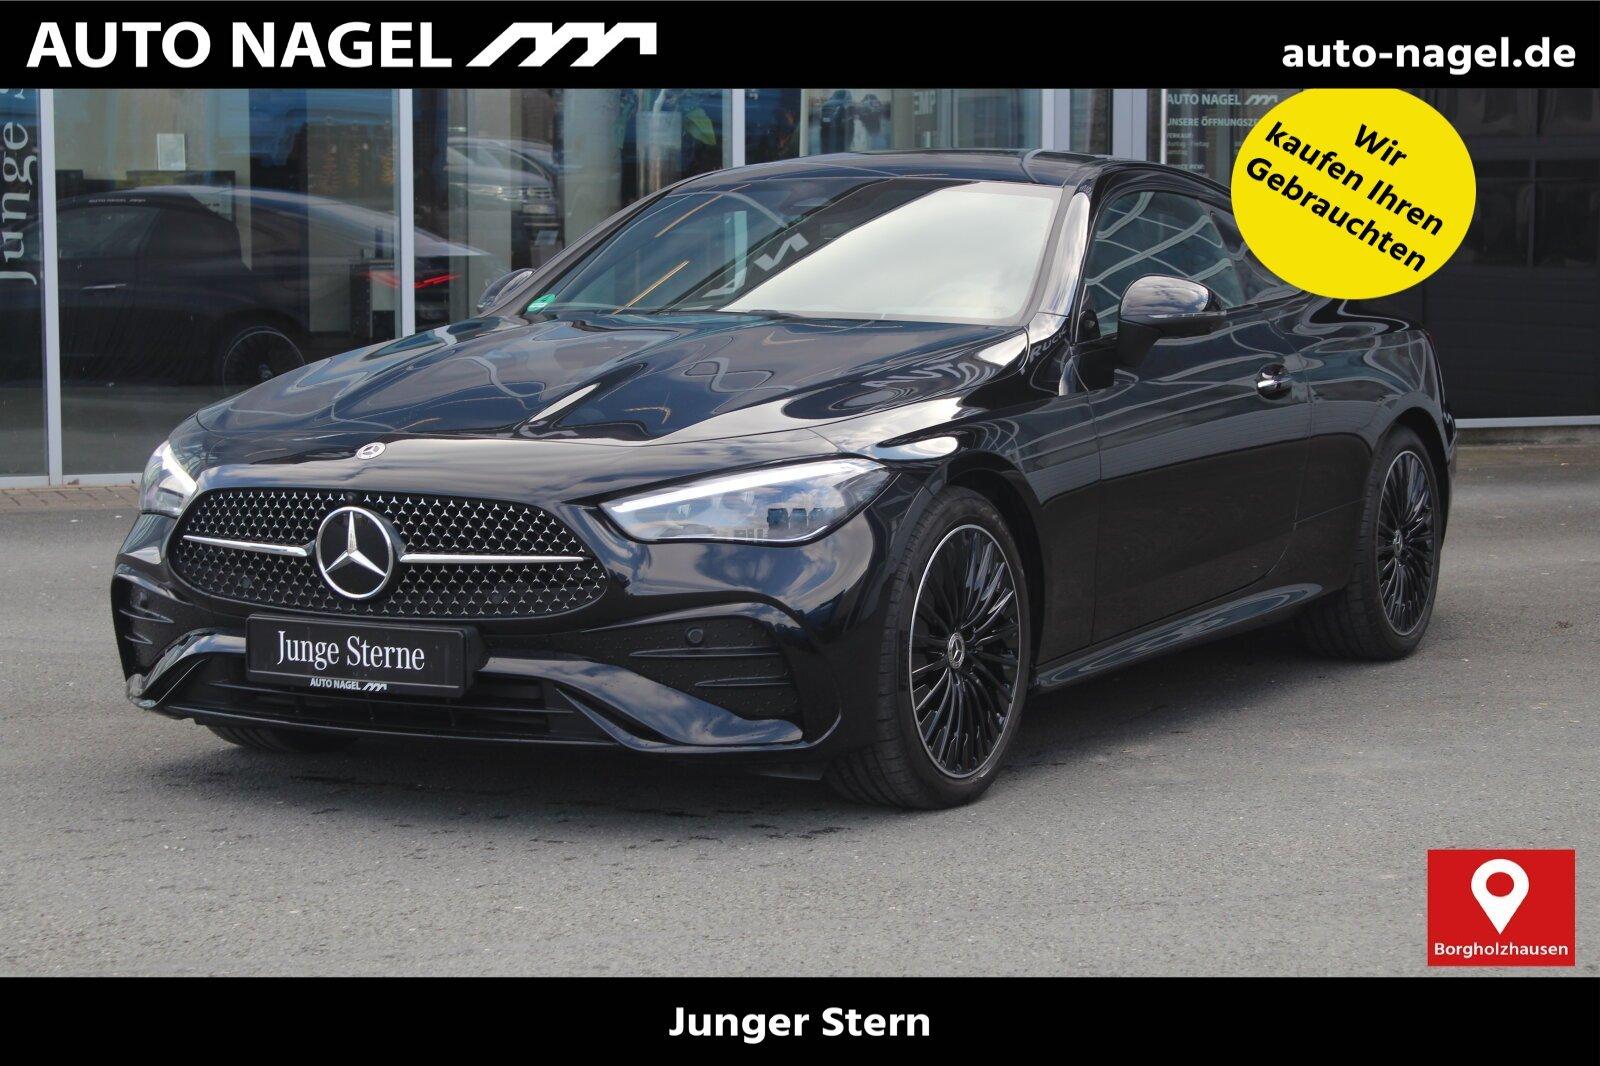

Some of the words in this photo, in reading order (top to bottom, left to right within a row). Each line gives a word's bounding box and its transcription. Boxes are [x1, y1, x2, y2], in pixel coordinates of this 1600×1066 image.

[1167, 94, 1199, 106] AUTO
[1201, 94, 1242, 106] NAGEL
[276, 630, 340, 671] Junge
[346, 635, 425, 670] Sterne
[310, 677, 333, 688] AUTO
[333, 679, 362, 691] NAGEL
